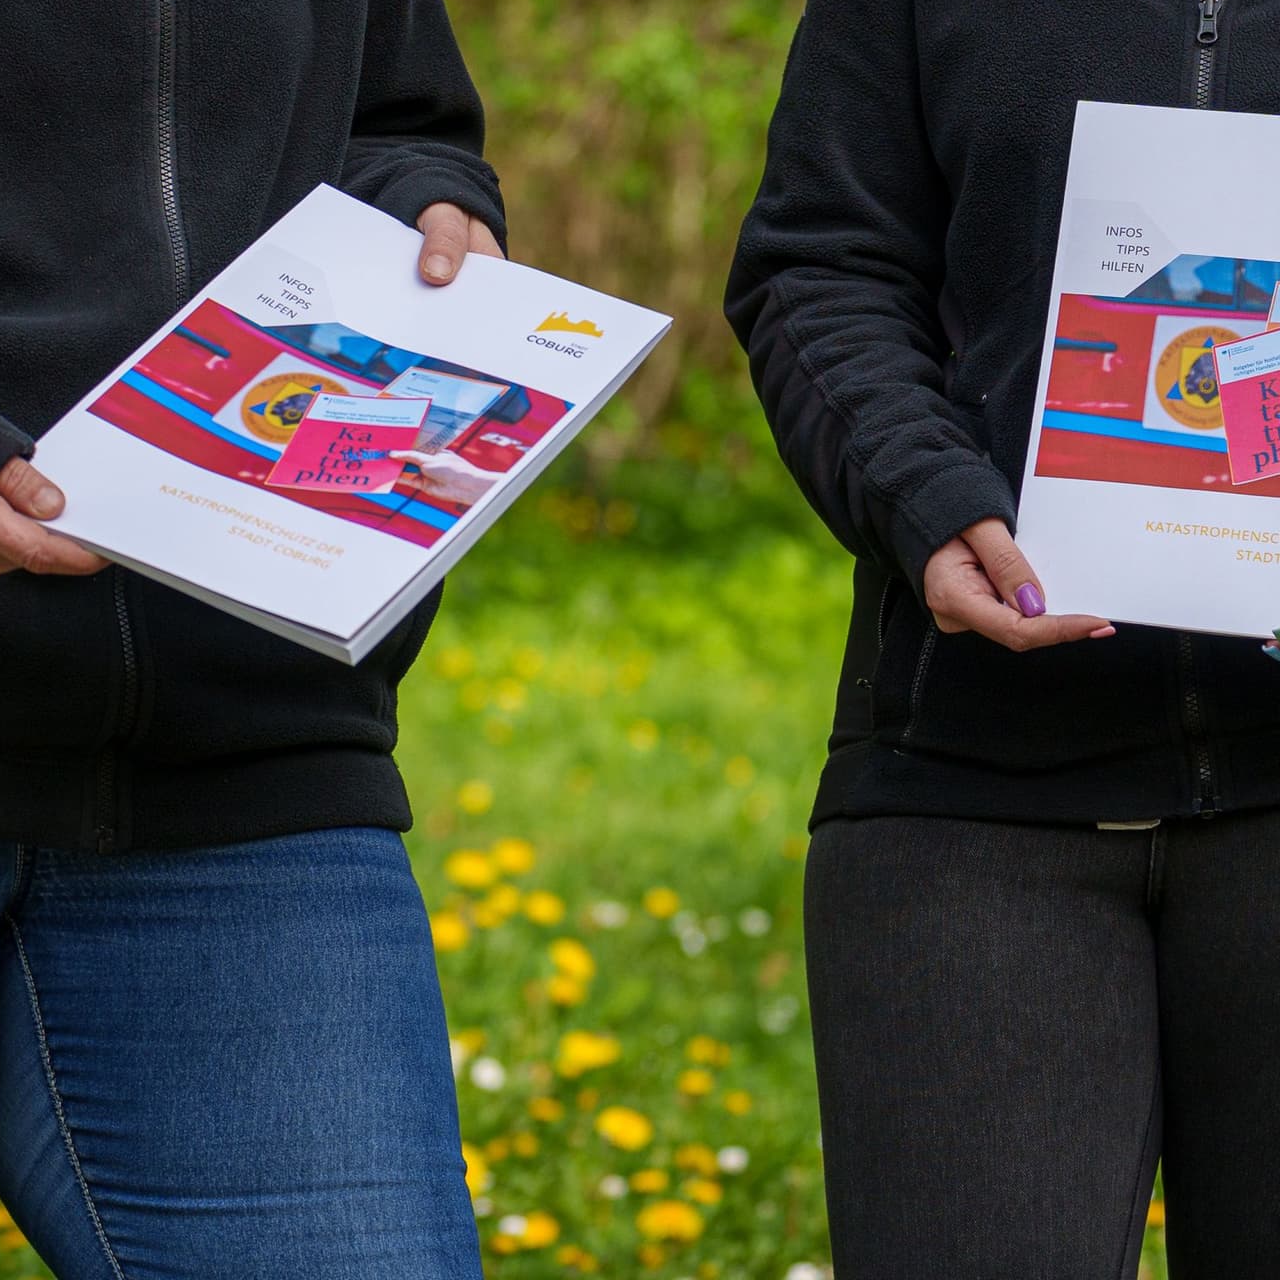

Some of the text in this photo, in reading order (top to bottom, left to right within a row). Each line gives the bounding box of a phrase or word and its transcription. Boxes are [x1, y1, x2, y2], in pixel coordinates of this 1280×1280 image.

[1105, 225, 1144, 238] INFOS
[1116, 244, 1151, 257] TIPPS
[1101, 260, 1145, 273] HILFEN
[278, 272, 315, 296] INFOS
[256, 293, 298, 319] HILFEN
[280, 288, 312, 310] TIPPS
[525, 334, 585, 359] COBURG
[338, 426, 373, 443] Ka
[293, 468, 370, 486] phen
